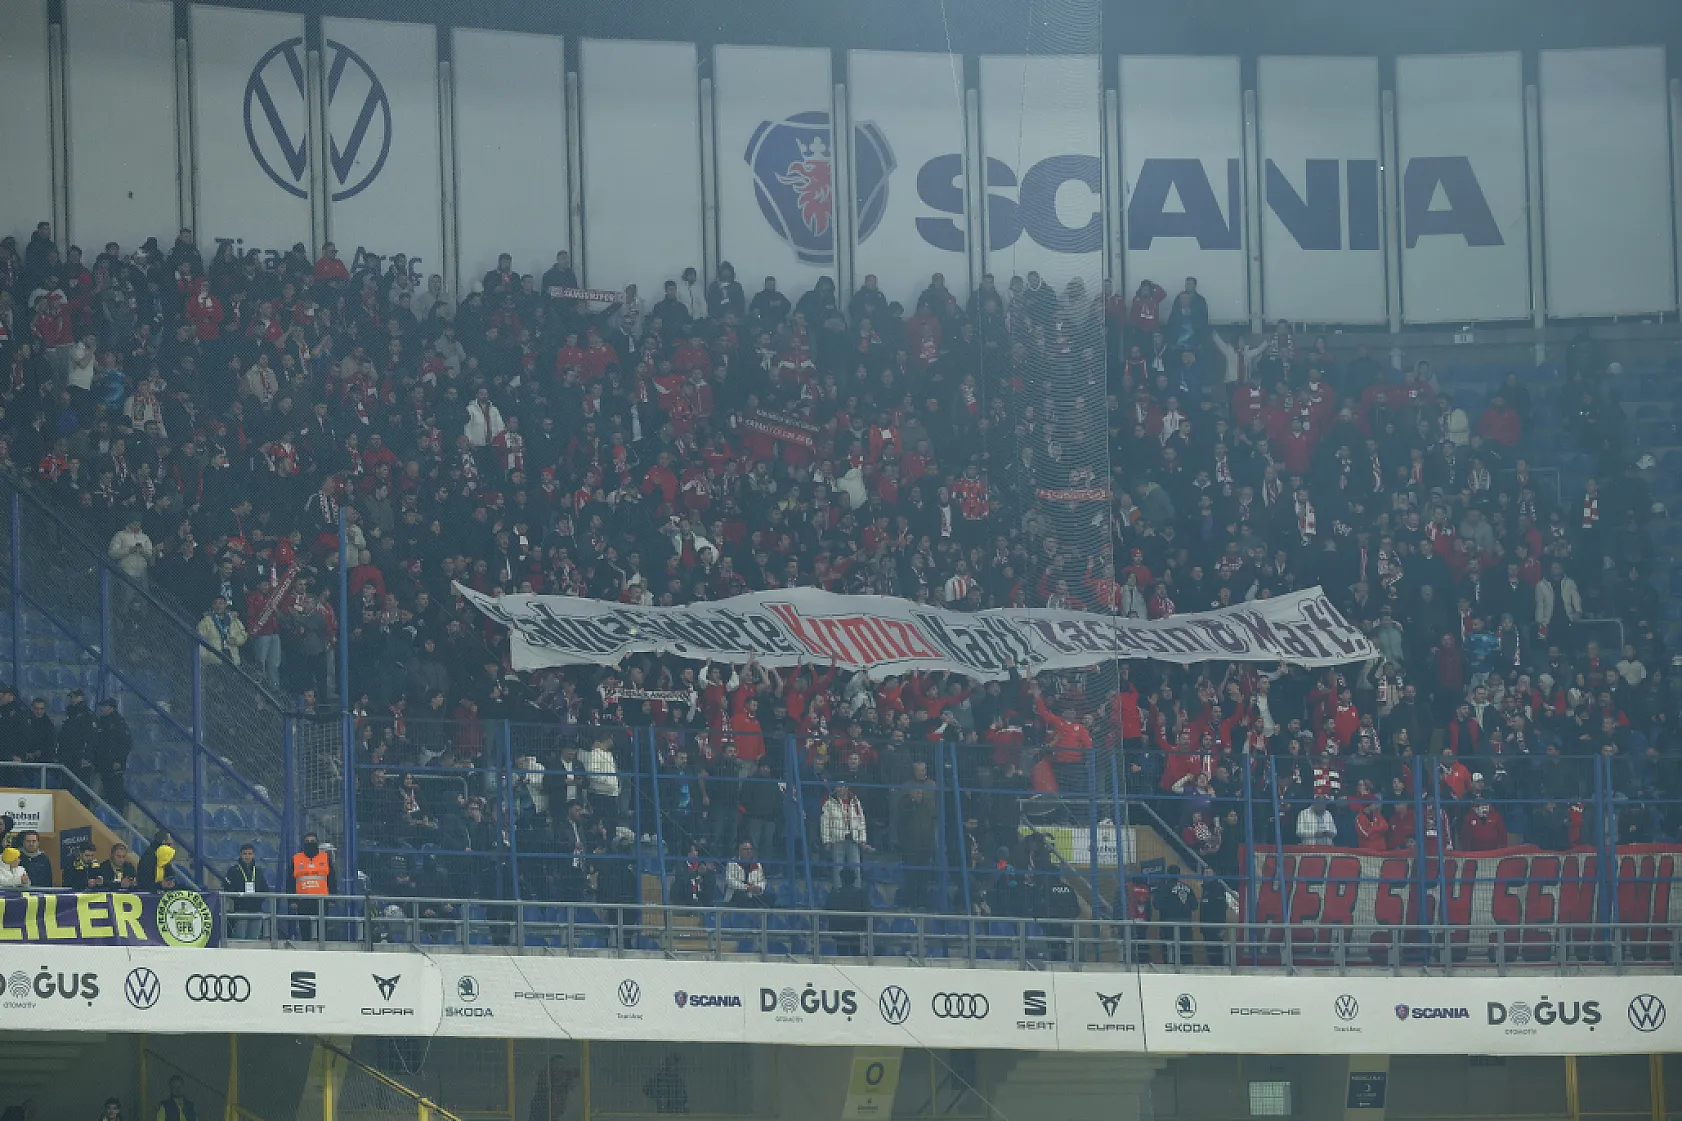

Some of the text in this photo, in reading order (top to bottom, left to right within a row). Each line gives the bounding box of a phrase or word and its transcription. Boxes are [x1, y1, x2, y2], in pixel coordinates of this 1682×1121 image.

[914, 154, 1505, 253] SCANIA
[514, 991, 586, 1001] PORSCHE
[689, 995, 742, 1007] SCANIA
[282, 1004, 326, 1014] SEAT
[361, 1007, 414, 1016] CUPRA
[1230, 1007, 1301, 1016] PORSCHE
[1411, 1007, 1470, 1019] SCANIA
[1016, 1021, 1055, 1030] SEAT
[1087, 1024, 1135, 1032] CUPRA
